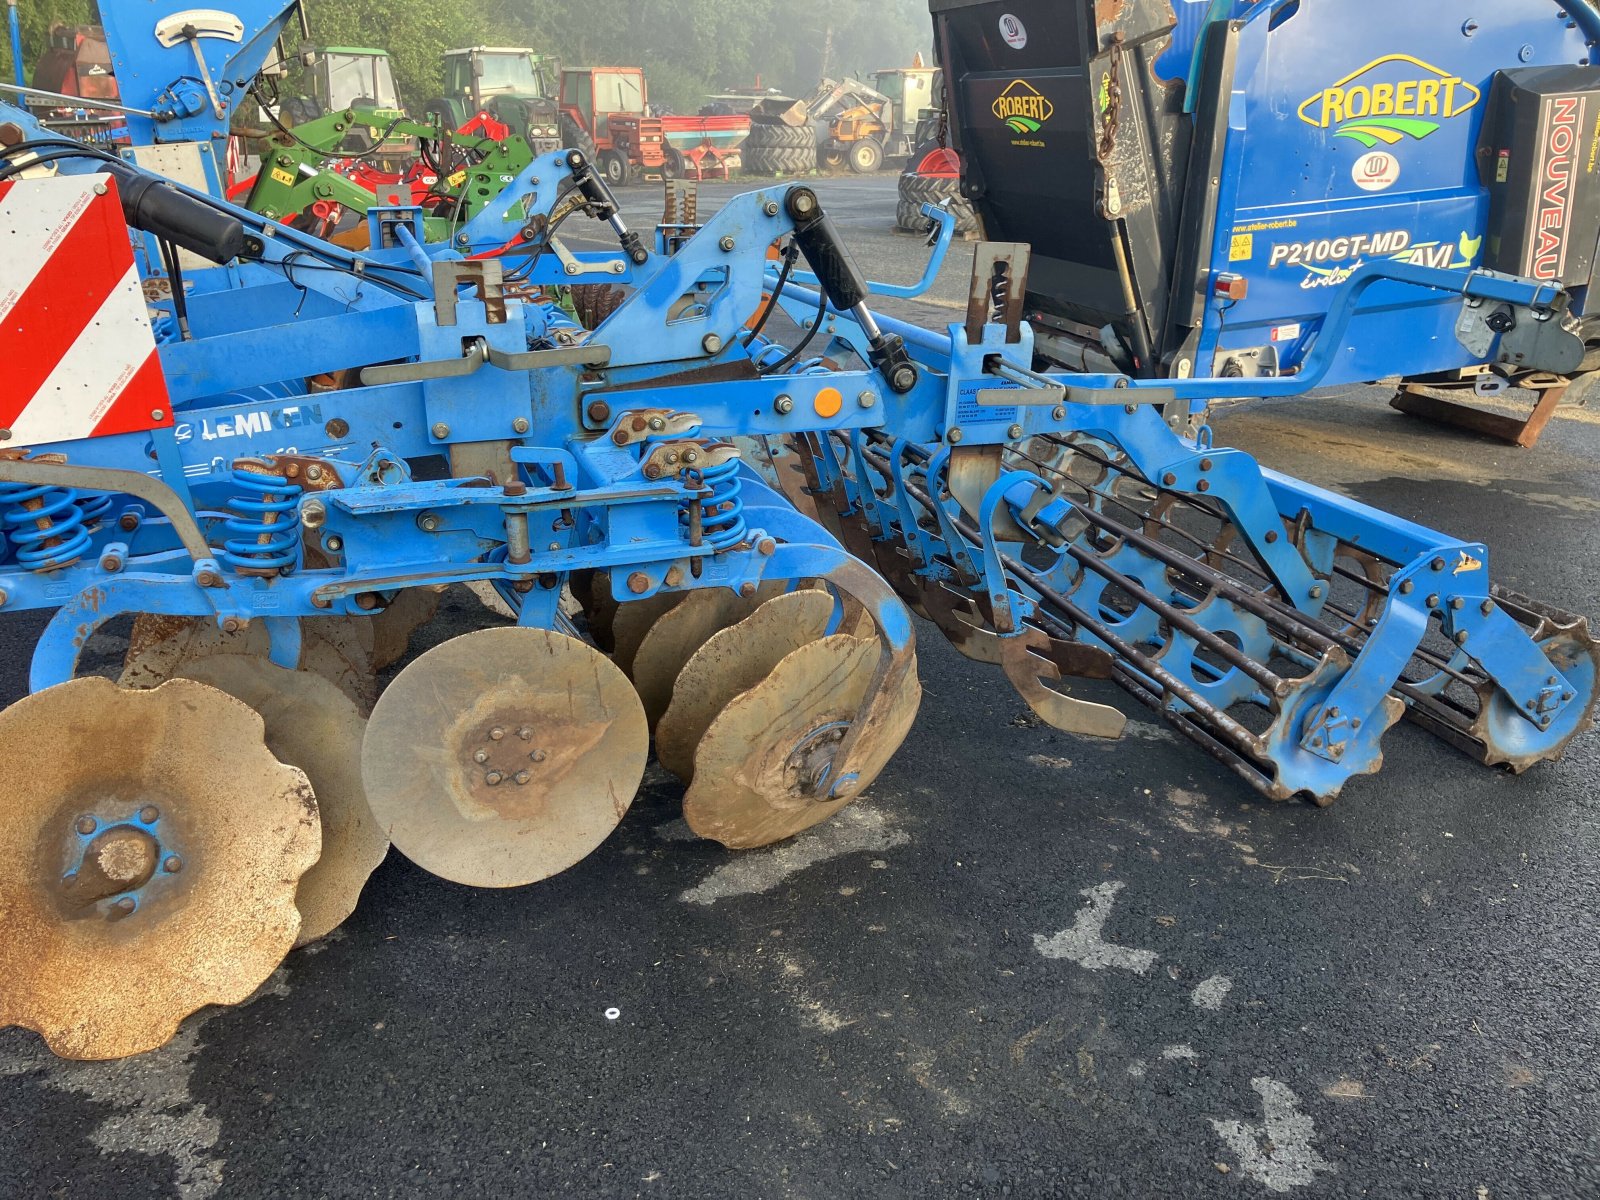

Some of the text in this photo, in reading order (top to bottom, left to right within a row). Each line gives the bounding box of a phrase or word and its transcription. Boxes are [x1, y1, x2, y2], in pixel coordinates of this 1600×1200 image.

[998, 95, 1045, 121] ROBERT
[1320, 77, 1462, 128] ROBERT
[1533, 97, 1578, 280] NOUVEAU
[1269, 230, 1409, 267] P210GT-MD
[1408, 243, 1454, 268] AVI
[959, 388, 976, 396] CLAAS
[201, 403, 323, 442] LEMKEN
